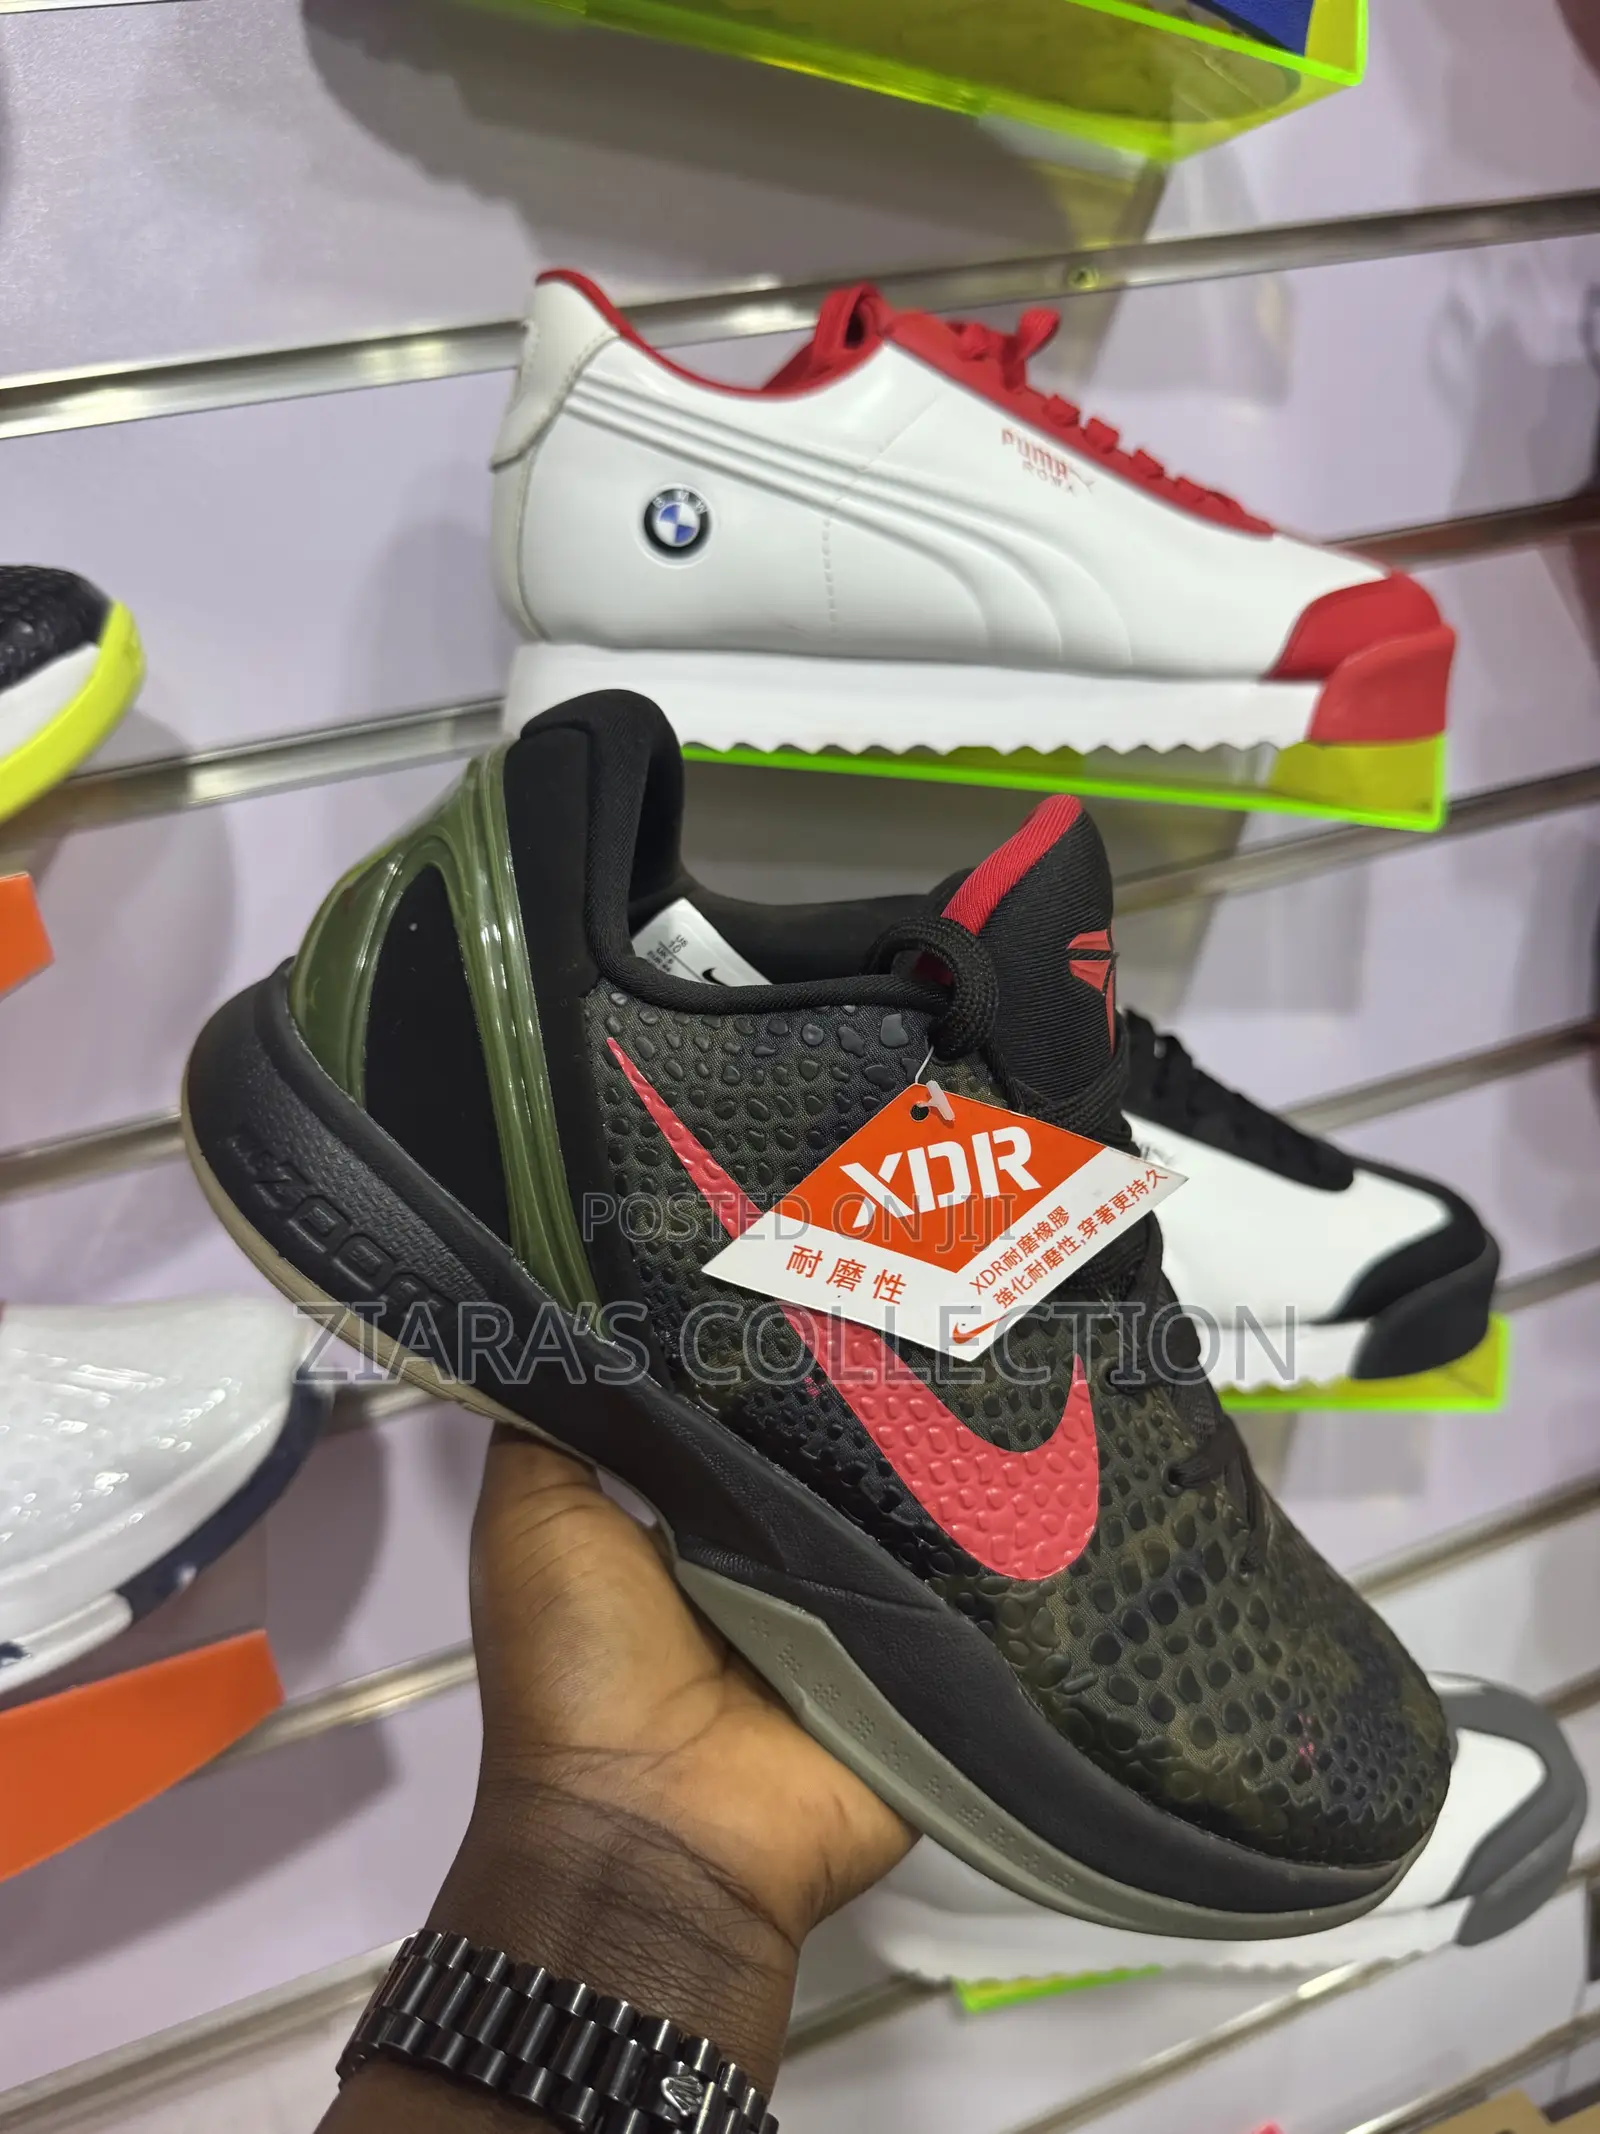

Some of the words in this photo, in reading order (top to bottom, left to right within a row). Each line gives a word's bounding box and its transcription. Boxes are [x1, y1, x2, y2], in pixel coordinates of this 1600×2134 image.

[652, 488, 709, 514] BMW
[840, 1126, 1042, 1228] XDR
[786, 1245, 907, 1305] 耐磨性
[969, 1205, 1070, 1295] XDR耐磨橡膠
